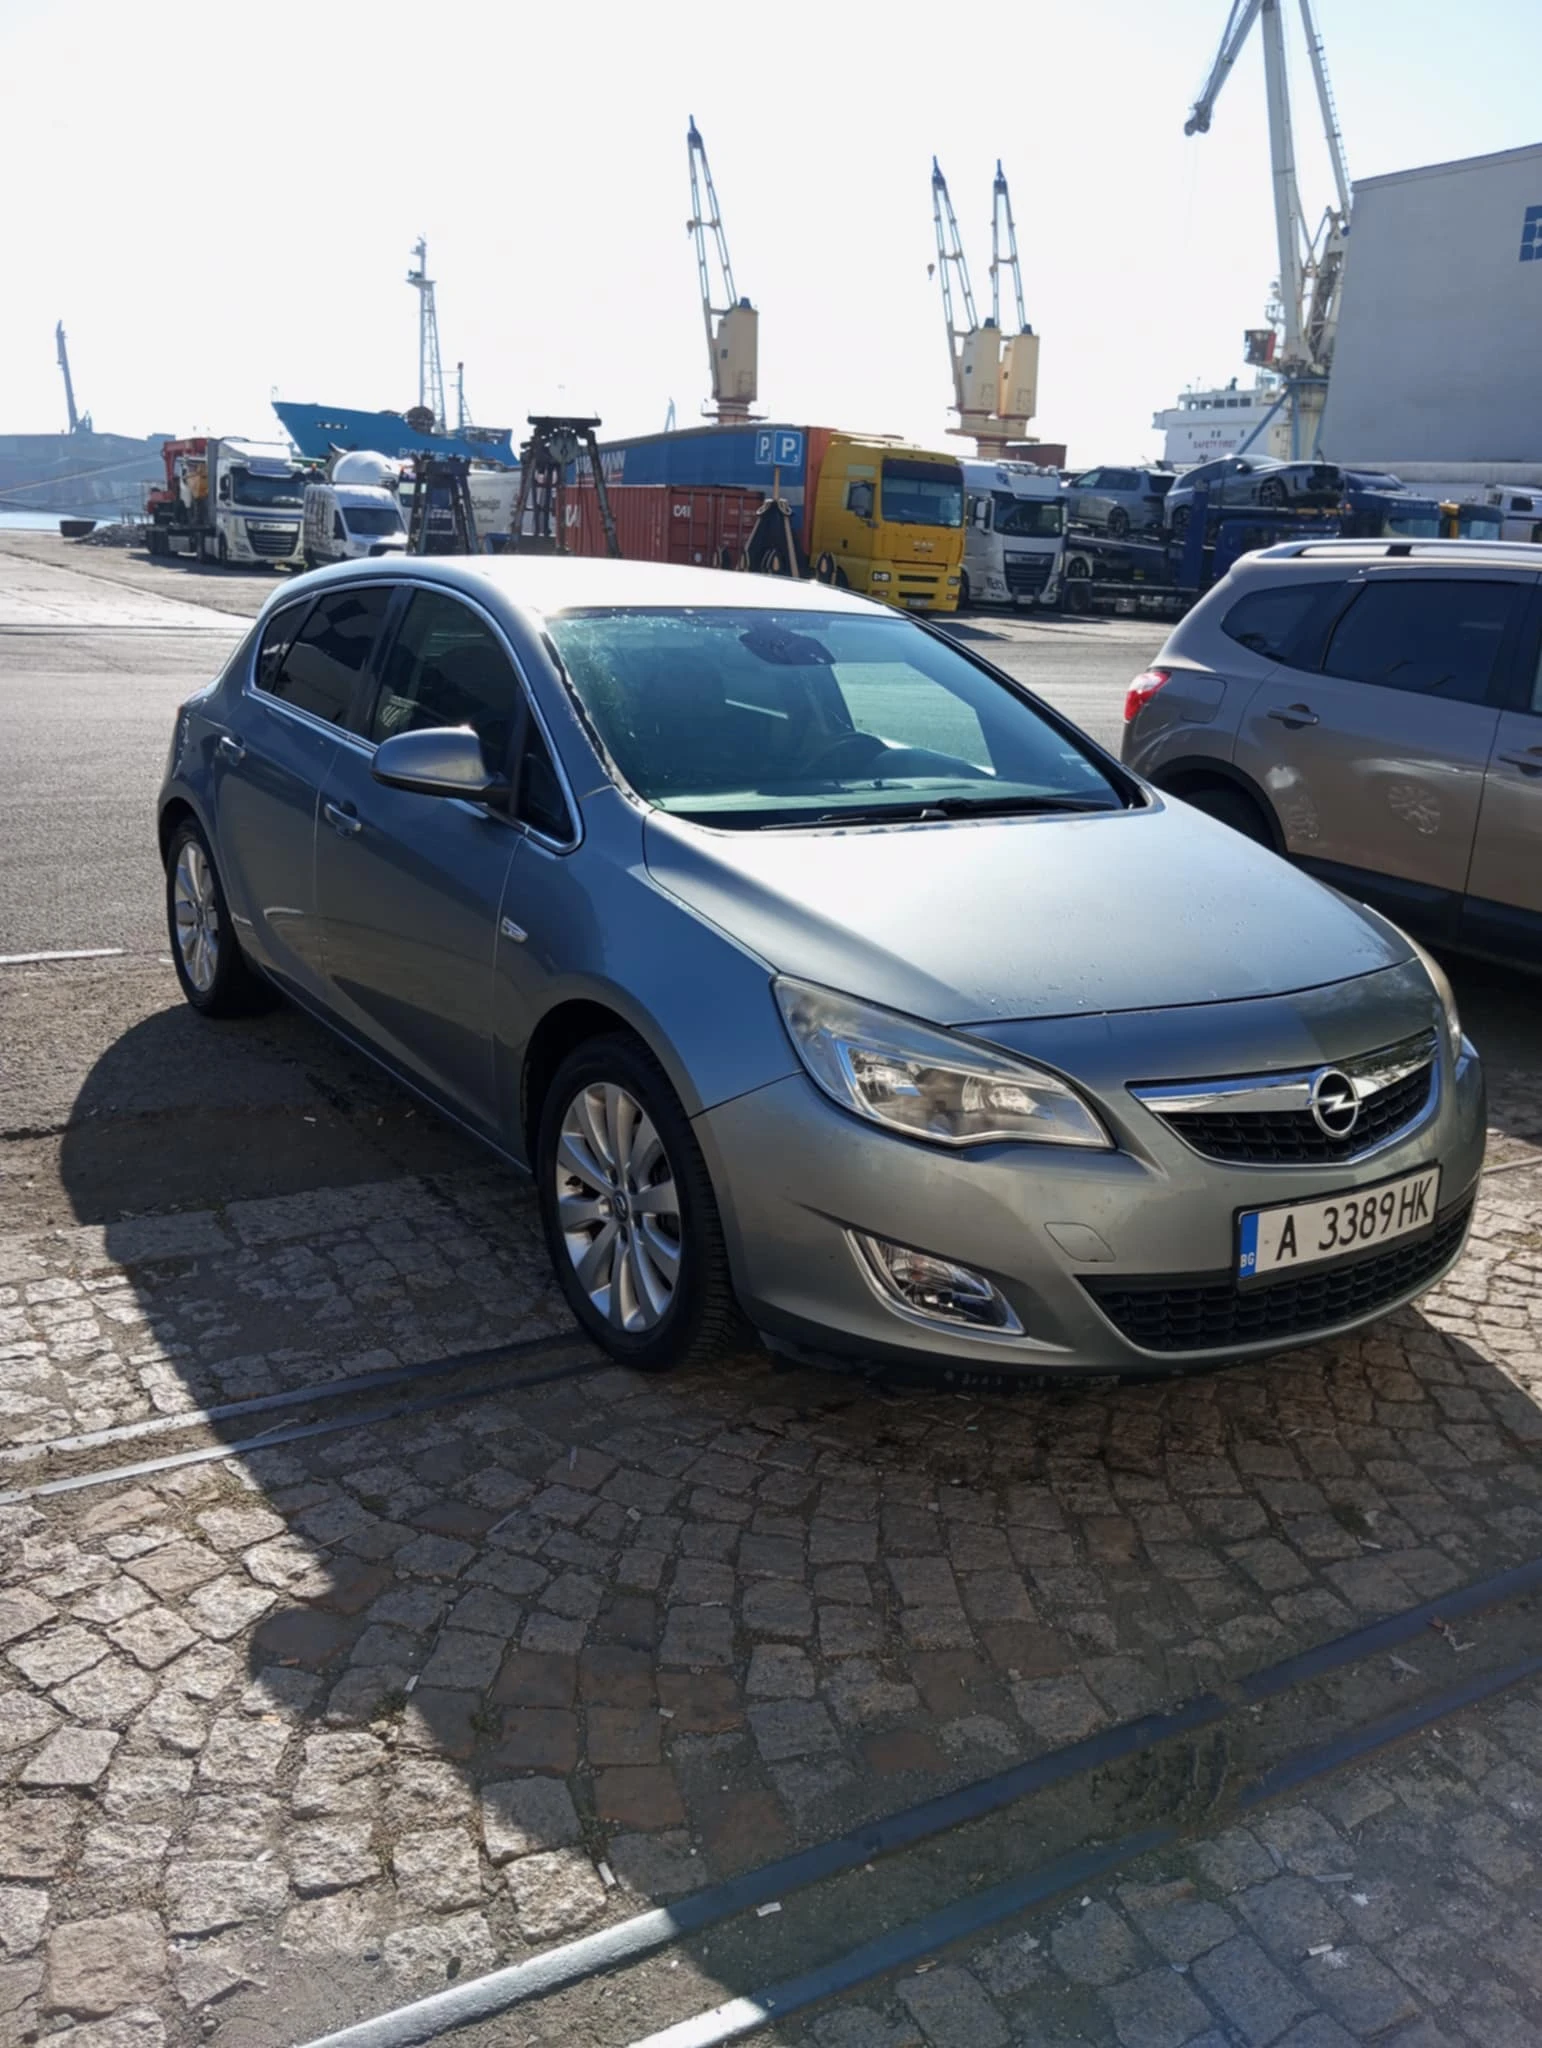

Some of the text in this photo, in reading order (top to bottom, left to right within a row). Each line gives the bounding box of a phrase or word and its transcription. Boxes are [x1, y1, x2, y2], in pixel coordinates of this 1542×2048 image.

[760, 436, 770, 458] P
[781, 437, 796, 459] P
[673, 504, 691, 518] CAI
[1276, 1214, 1297, 1261] A
[1240, 1252, 1256, 1268] BG
